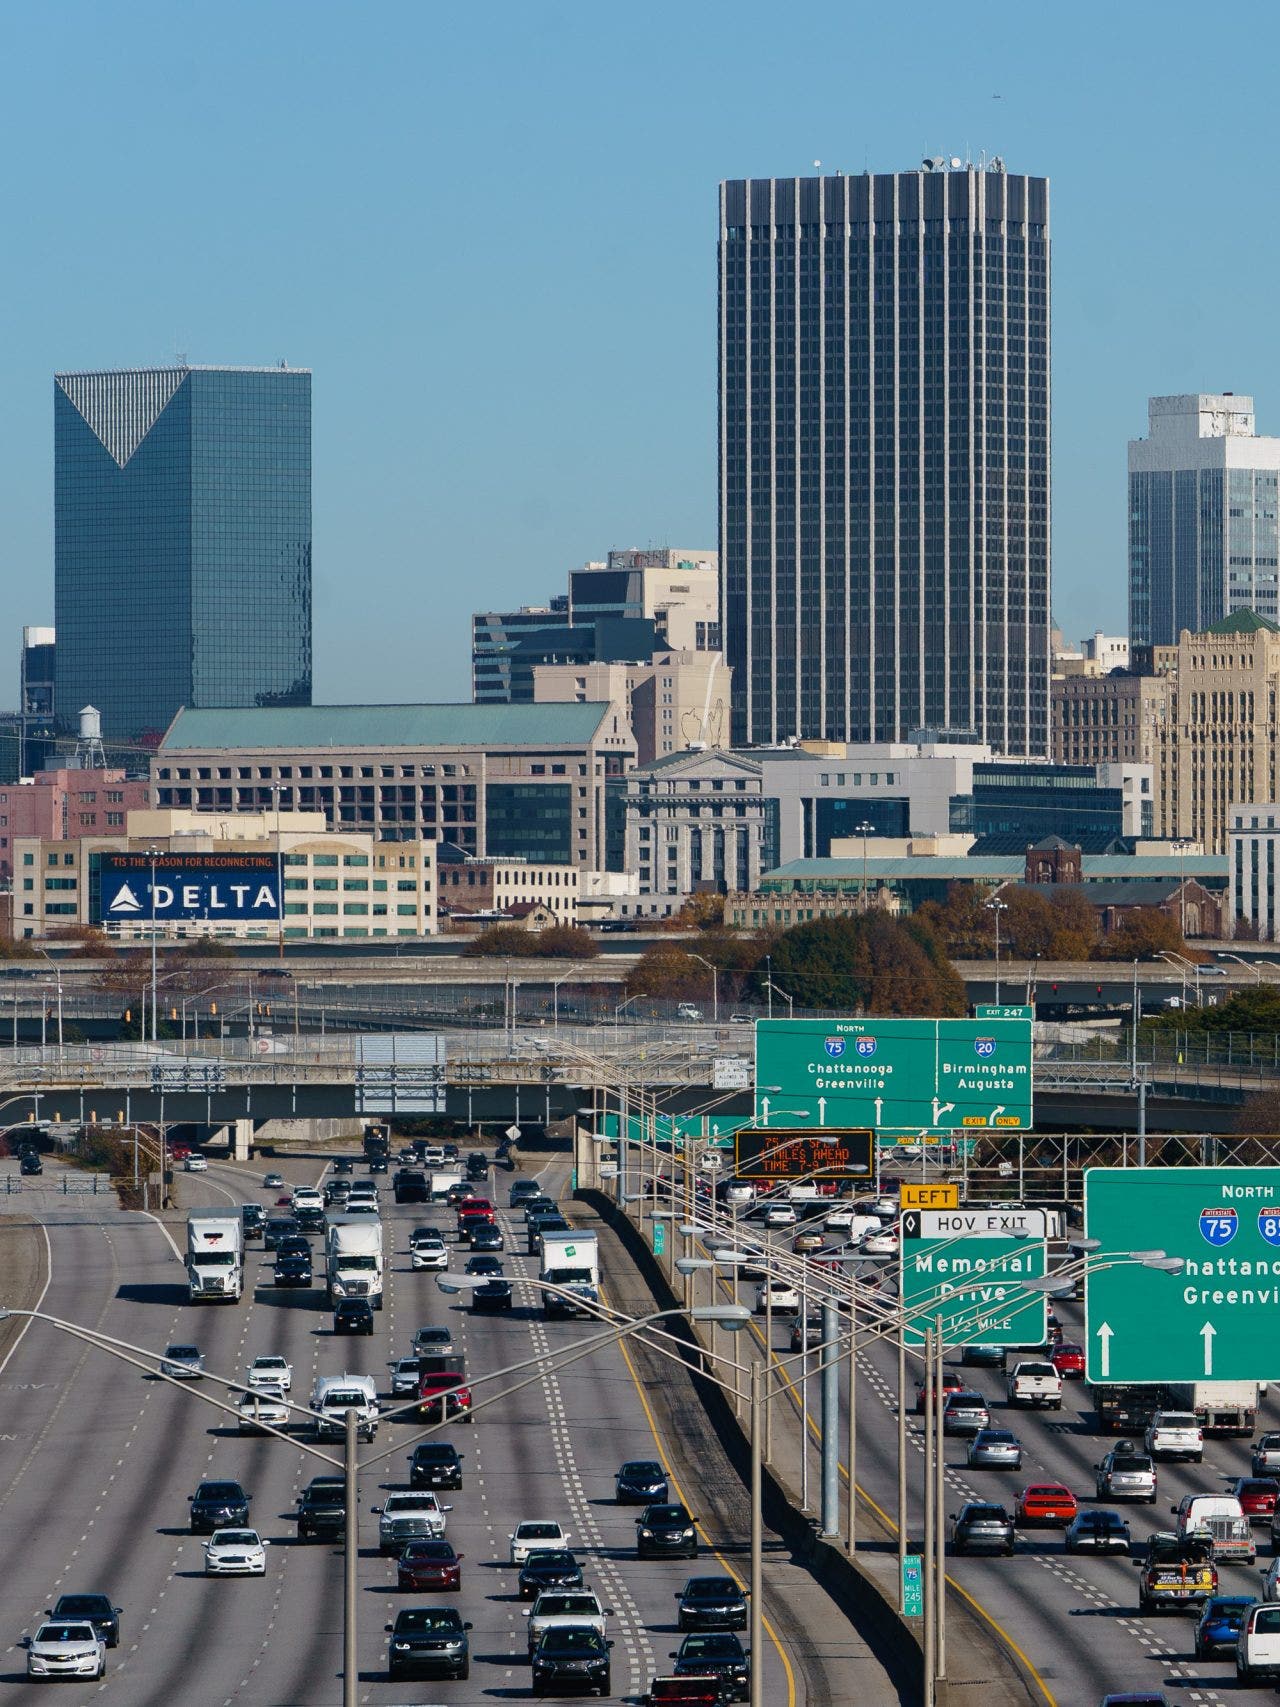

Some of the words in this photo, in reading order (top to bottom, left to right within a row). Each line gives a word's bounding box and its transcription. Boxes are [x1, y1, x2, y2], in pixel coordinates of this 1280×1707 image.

[128, 857, 146, 867] THE
[148, 857, 183, 867] SEASON
[185, 857, 200, 867] FOR
[204, 857, 273, 867] RECONNECTING.
[153, 885, 277, 908] DELTA
[1003, 1008, 1023, 1017] 247
[836, 1024, 865, 1032] NORTH
[828, 1042, 842, 1053] 75
[858, 1042, 874, 1053] 85
[978, 1042, 993, 1054] 20
[807, 1063, 893, 1076] Chattanooga
[942, 1063, 1028, 1076] Birmingham
[815, 1078, 885, 1089] Greenville
[958, 1078, 1014, 1091] Augusta
[997, 1117, 1019, 1125] ONLY
[773, 1149, 806, 1160] MILES
[813, 1149, 850, 1160] AHEAD
[761, 1160, 789, 1172] TIME
[907, 1190, 951, 1204] LEFT
[1222, 1185, 1274, 1198] NORTH
[938, 1217, 976, 1231] HOV
[987, 1217, 1027, 1231] EXIT
[1206, 1219, 1232, 1238] 75
[915, 1254, 1032, 1273] Memorial
[977, 1318, 1012, 1331] MILE
[907, 1571, 918, 1579] 75
[904, 1593, 921, 1602] 245
[910, 1605, 917, 1613] 4
